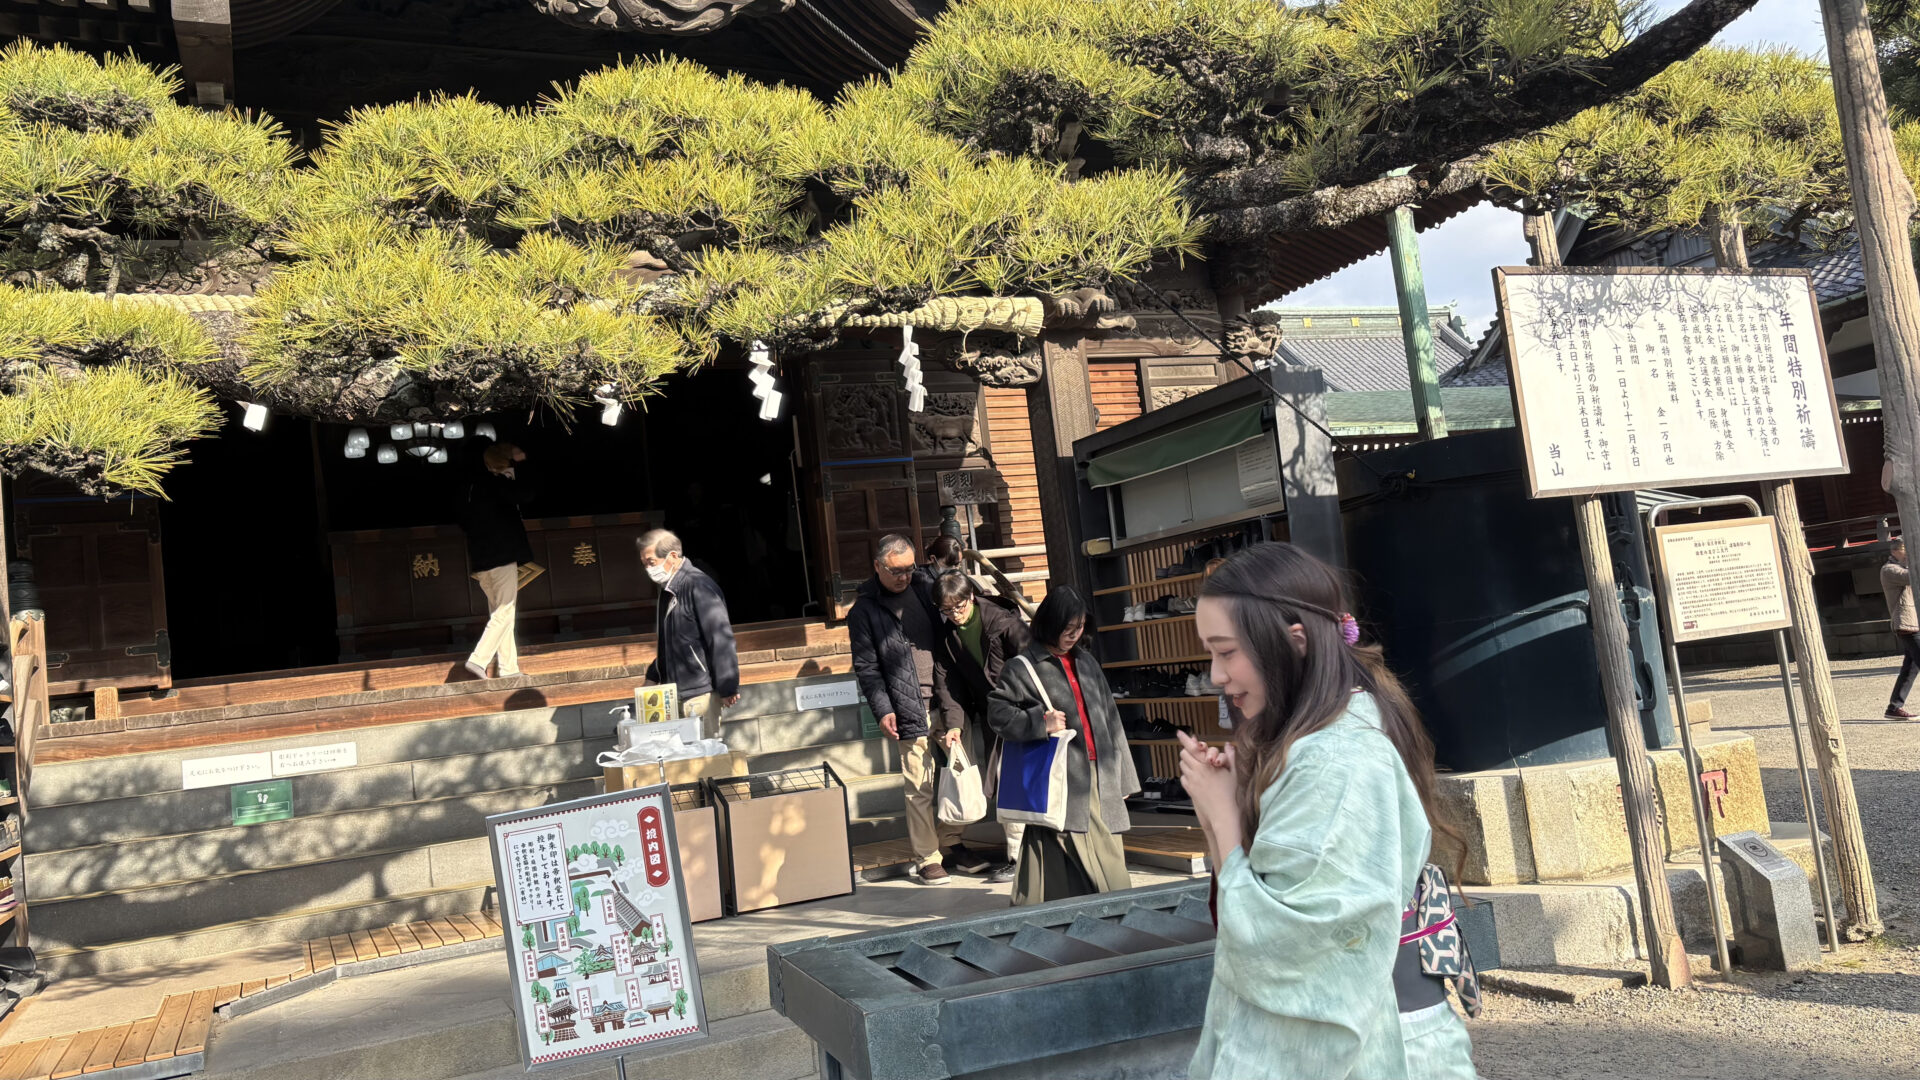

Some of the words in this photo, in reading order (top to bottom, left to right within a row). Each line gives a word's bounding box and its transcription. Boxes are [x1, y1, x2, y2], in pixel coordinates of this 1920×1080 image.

[1624, 321, 1640, 364] 申込期間
[1611, 343, 1641, 467] 十月一日より十二月末日
[1655, 406, 1674, 465] 金一万円也
[943, 472, 973, 488] 彫刻
[1547, 442, 1564, 477] 当山
[412, 553, 440, 579] 納
[571, 542, 597, 567] 奉
[536, 834, 555, 911] 授与しております。
[545, 832, 566, 910] 御朱印は帝釈堂にて
